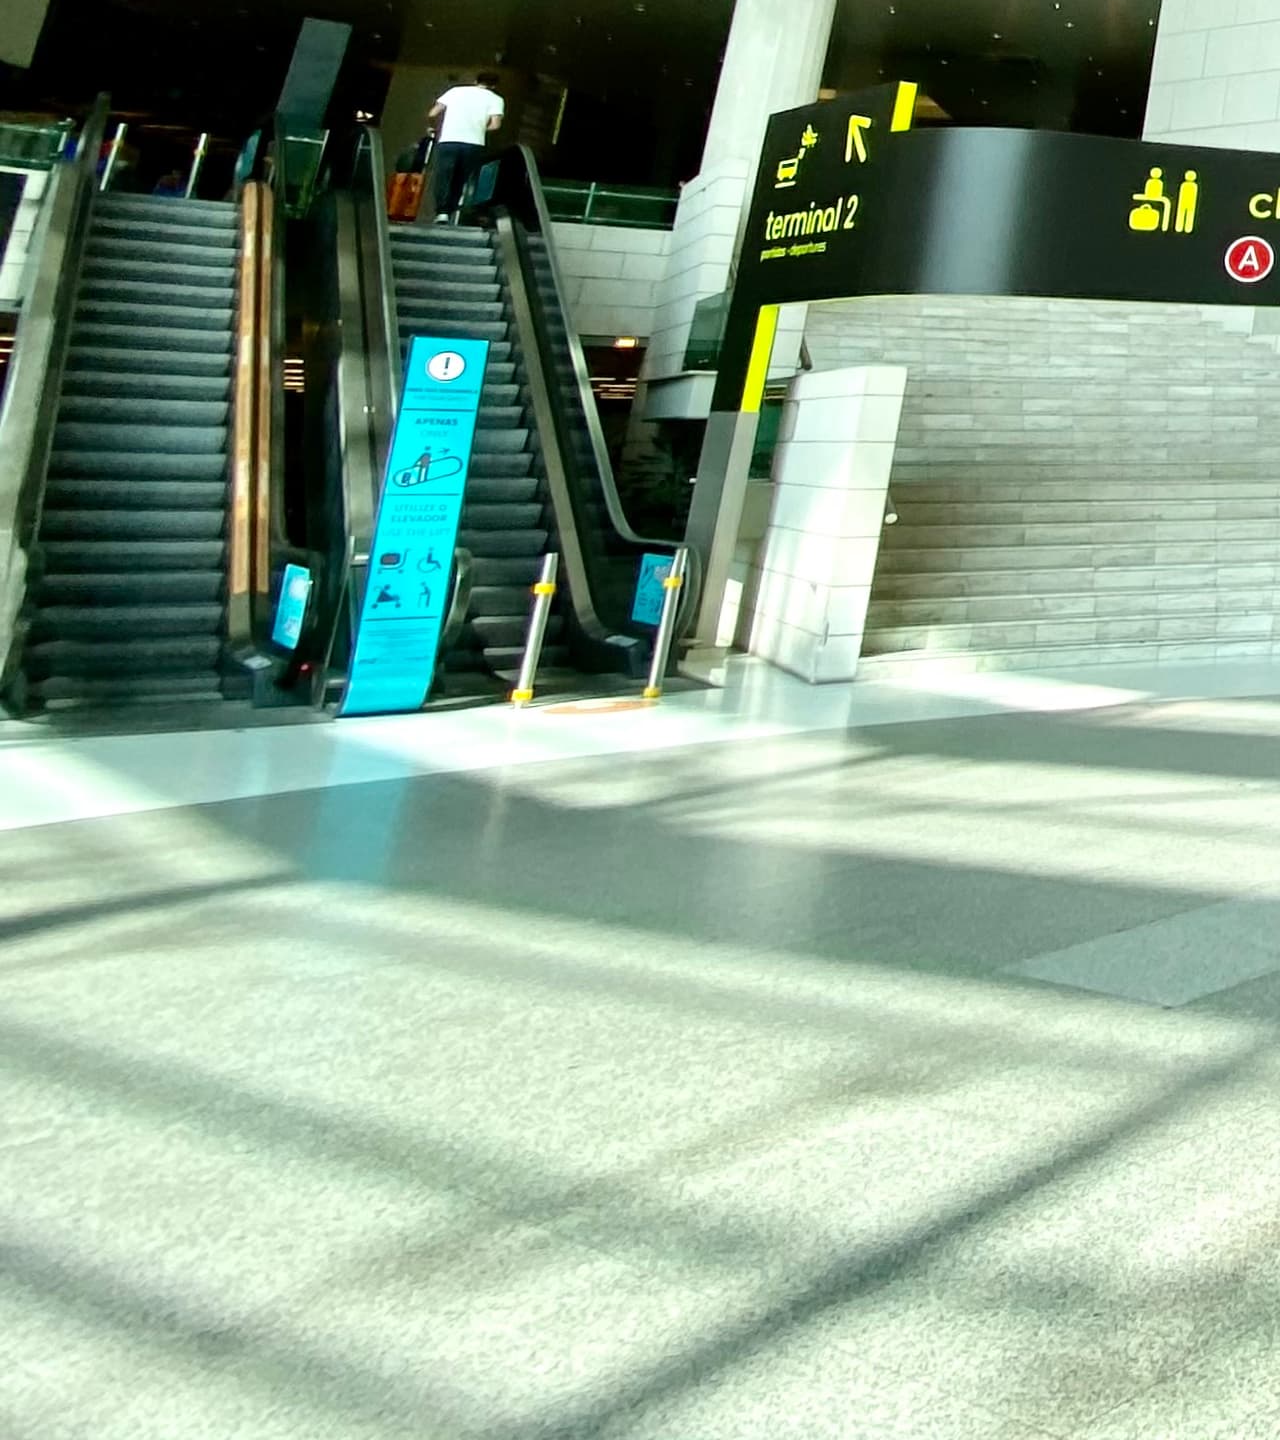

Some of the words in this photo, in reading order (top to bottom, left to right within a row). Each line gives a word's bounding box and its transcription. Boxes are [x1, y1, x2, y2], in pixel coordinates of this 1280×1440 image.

[765, 197, 843, 241] terminal
[843, 194, 858, 229] 2
[1238, 249, 1260, 271] A
[415, 418, 458, 426] APENAS
